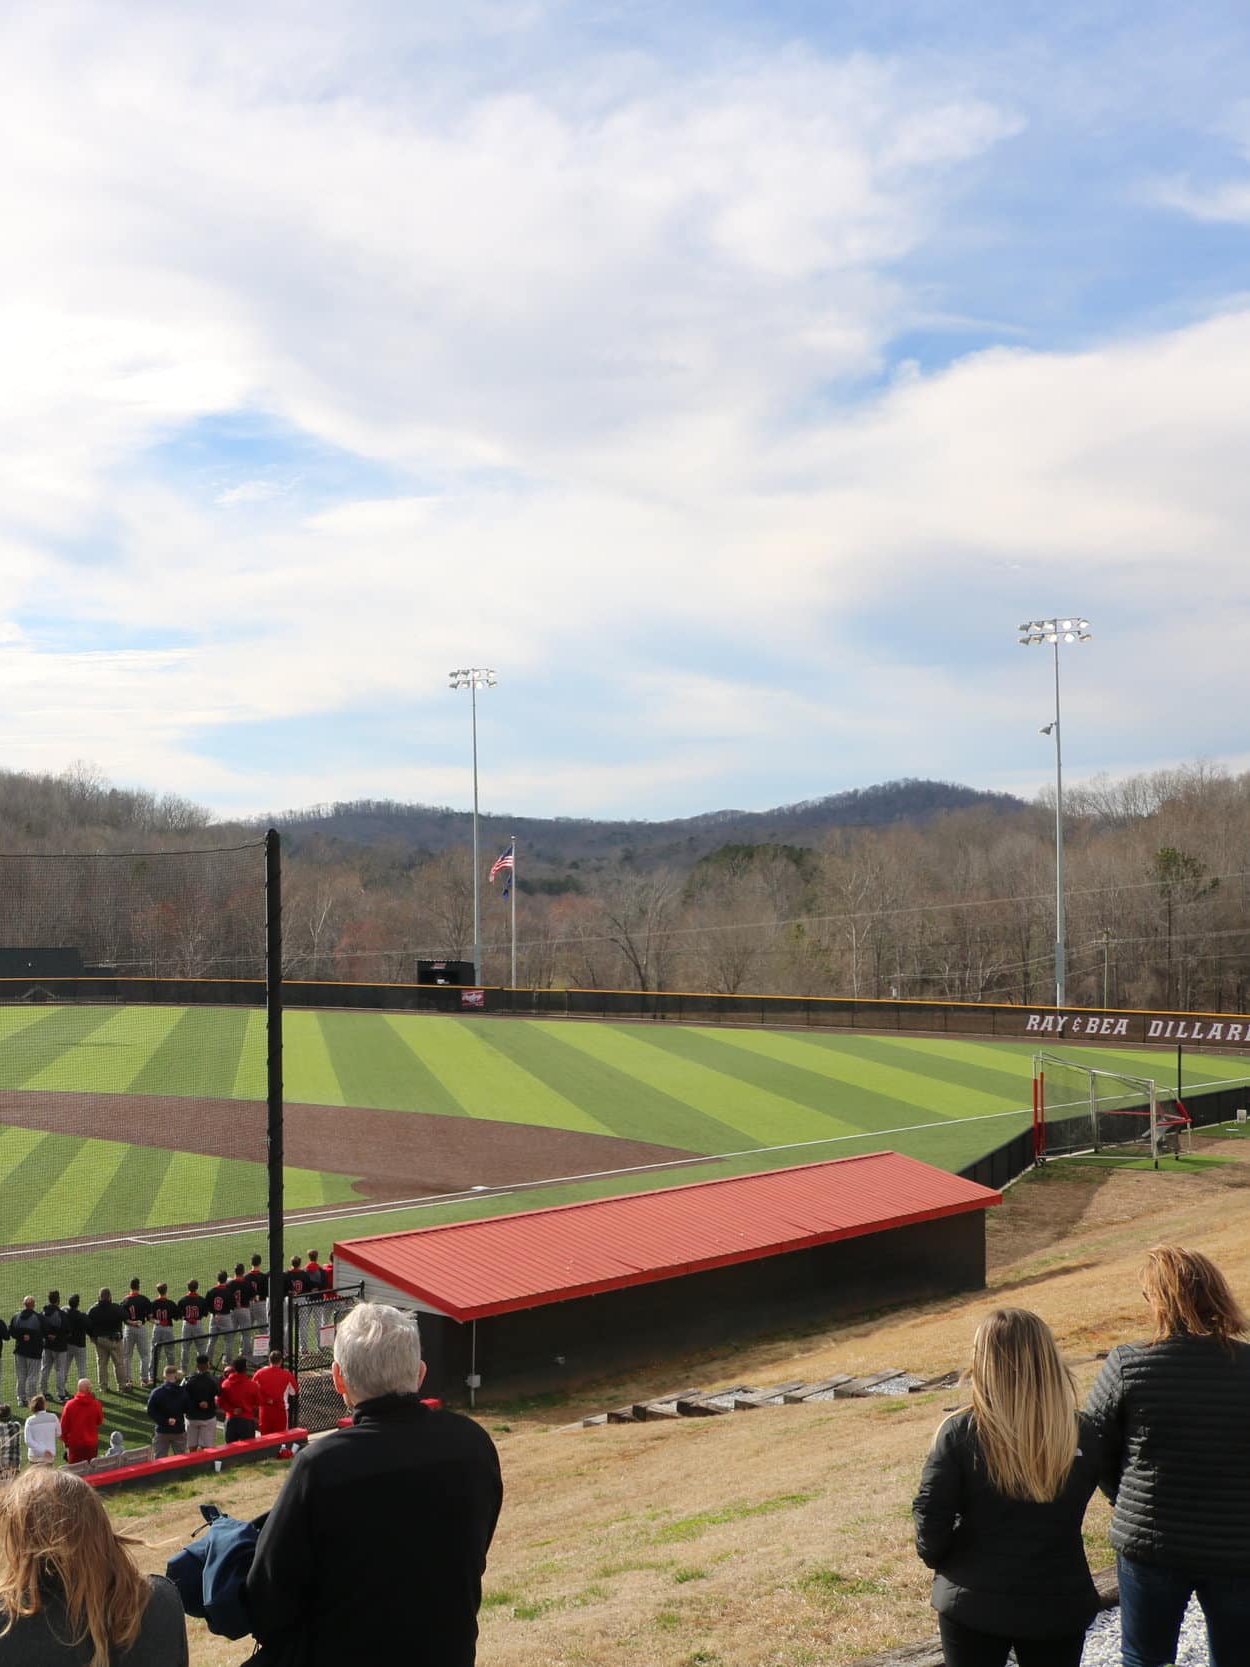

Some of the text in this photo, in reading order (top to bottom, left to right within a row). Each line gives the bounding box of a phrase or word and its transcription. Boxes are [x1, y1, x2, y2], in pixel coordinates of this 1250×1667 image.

[1026, 1014, 1069, 1032] RAY
[1072, 1016, 1082, 1032] &
[1085, 1017, 1130, 1036] BEA
